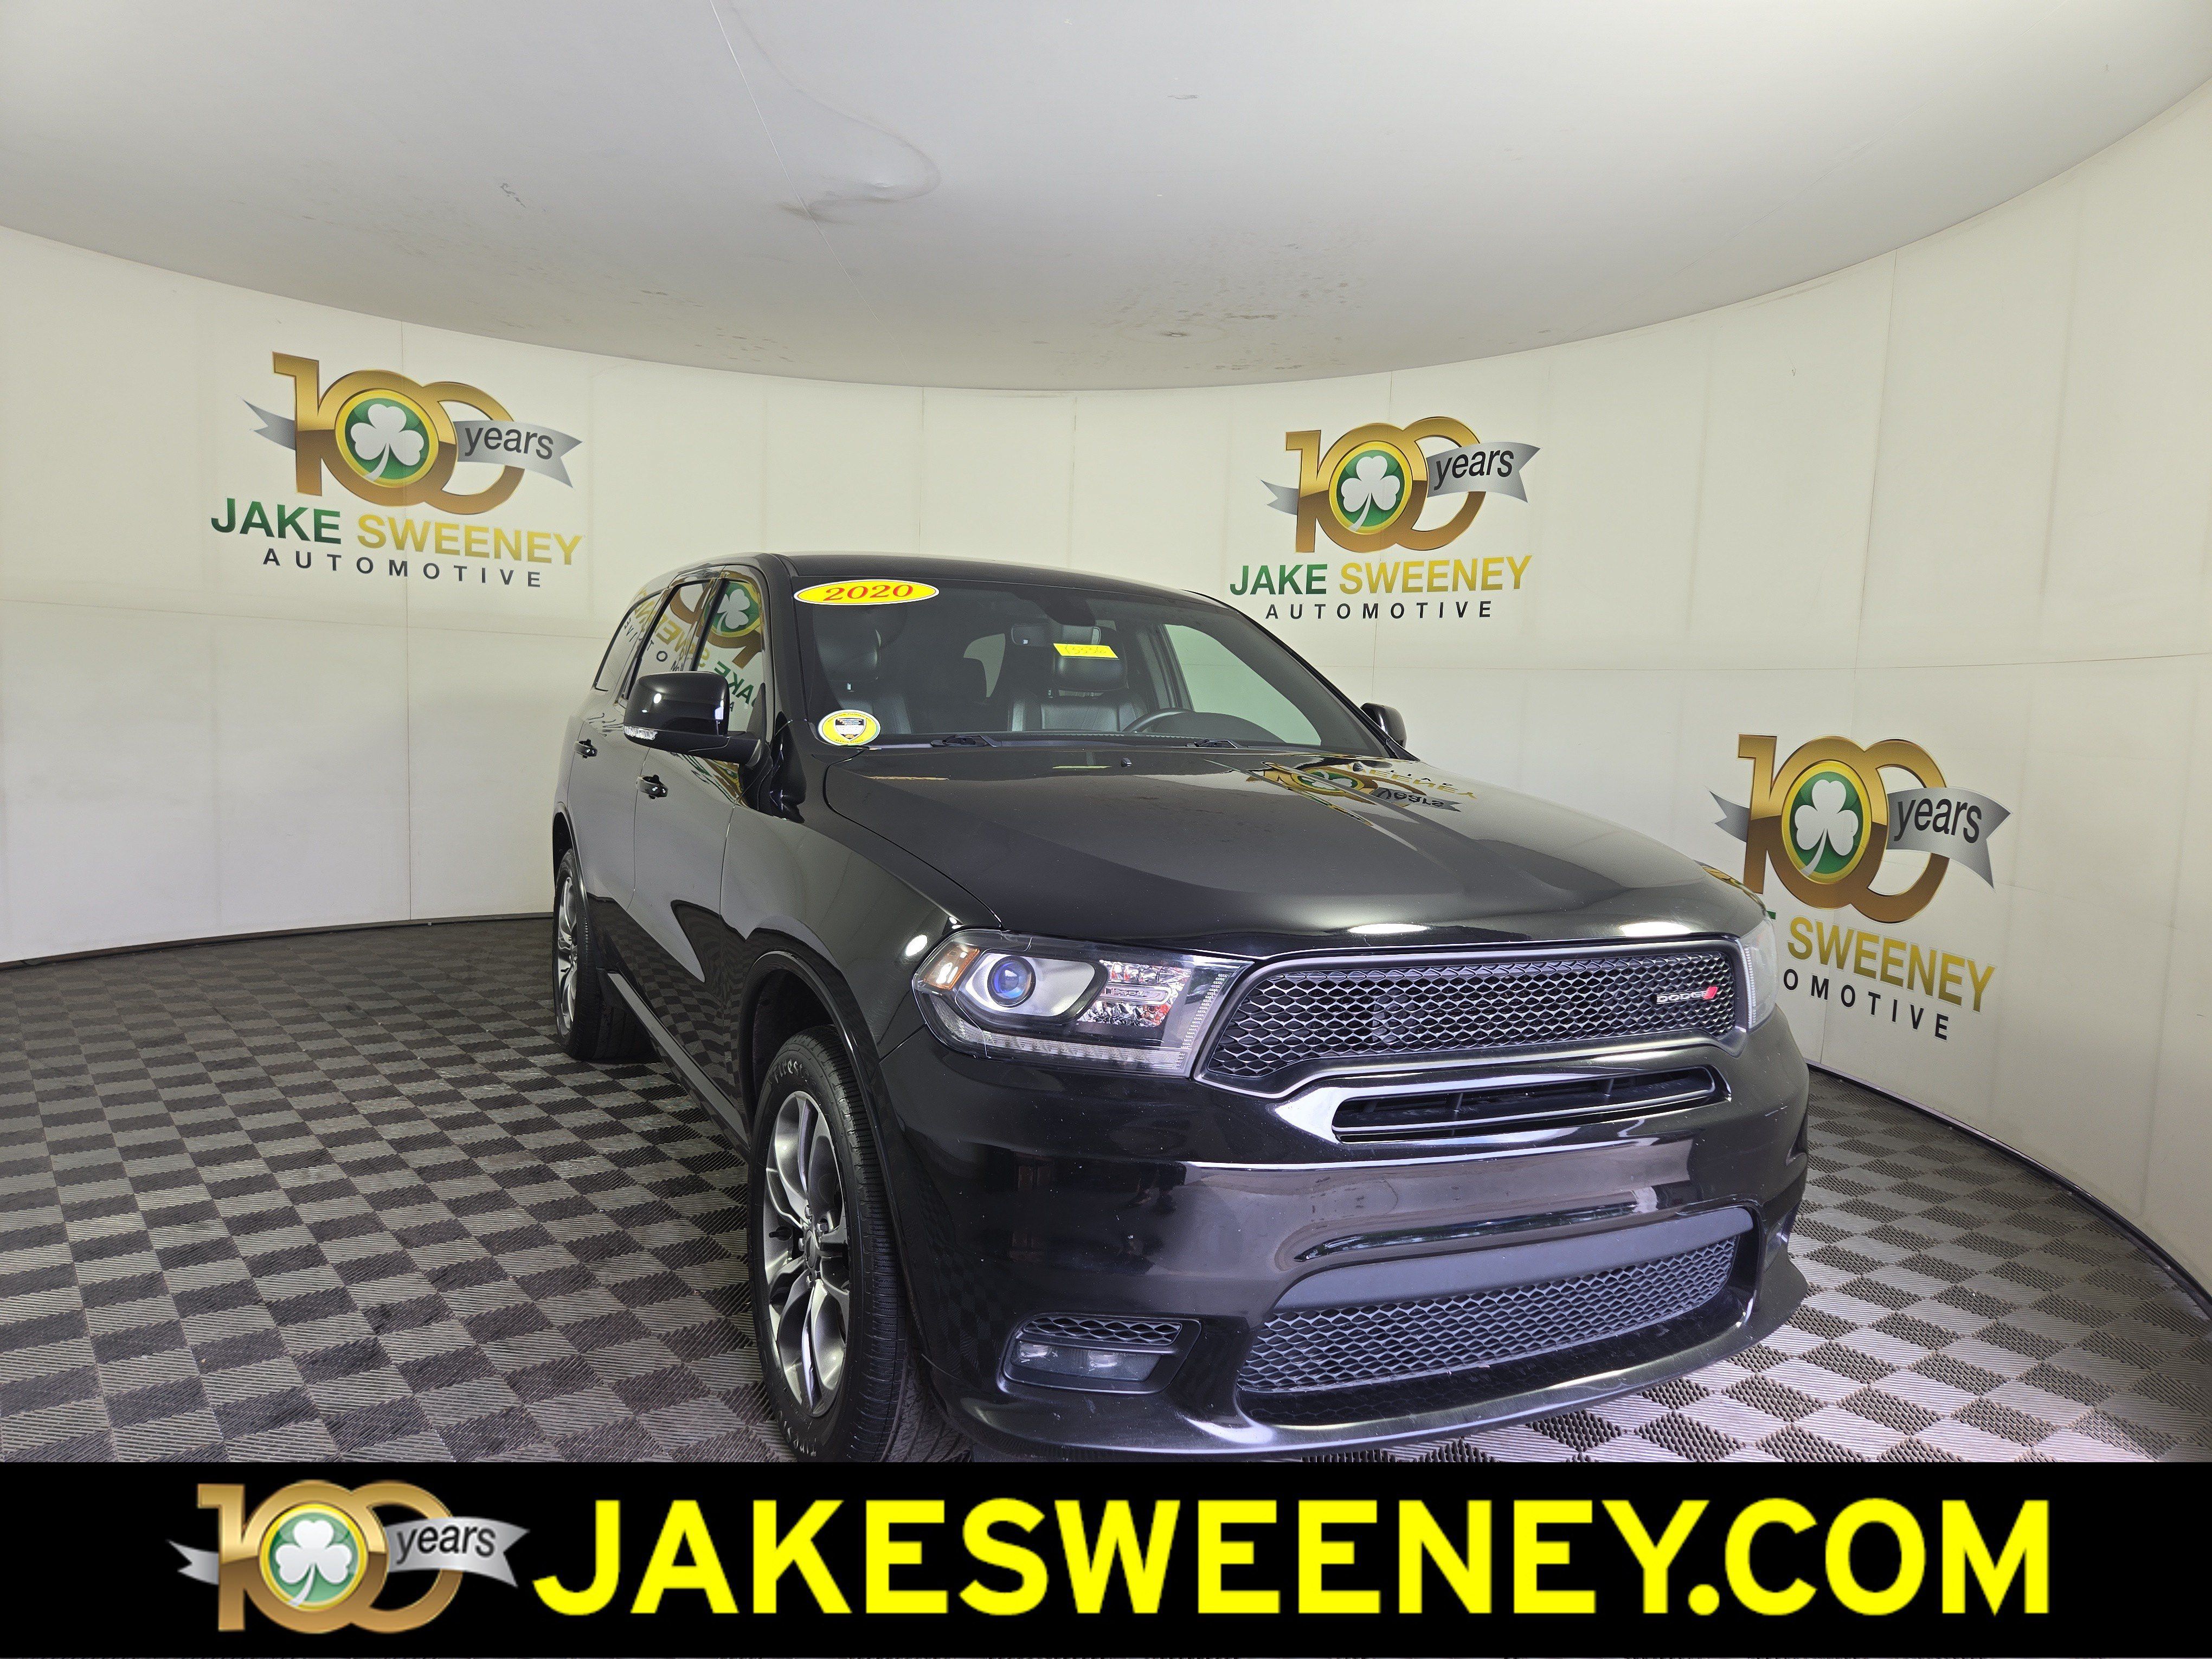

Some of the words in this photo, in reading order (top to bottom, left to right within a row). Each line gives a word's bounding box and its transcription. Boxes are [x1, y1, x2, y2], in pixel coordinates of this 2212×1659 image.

[272, 351, 525, 515] 100
[464, 425, 554, 460] years
[1285, 416, 1487, 553] 100
[1434, 447, 1514, 491] years
[211, 497, 342, 545] JAKE
[357, 514, 583, 565] SWEENEY
[263, 548, 541, 588] AUTOMOTIVE
[822, 584, 914, 602] 2020
[1230, 563, 1328, 595] JAKE
[1339, 555, 1533, 595] SWEENEY
[1265, 600, 1491, 620] AUTOMOTIVE
[1738, 734, 1950, 924] 100
[1894, 797, 1982, 844] years
[1787, 916, 1996, 1013] SWEENEY
[1783, 968, 1950, 1041] OMOTIVE
